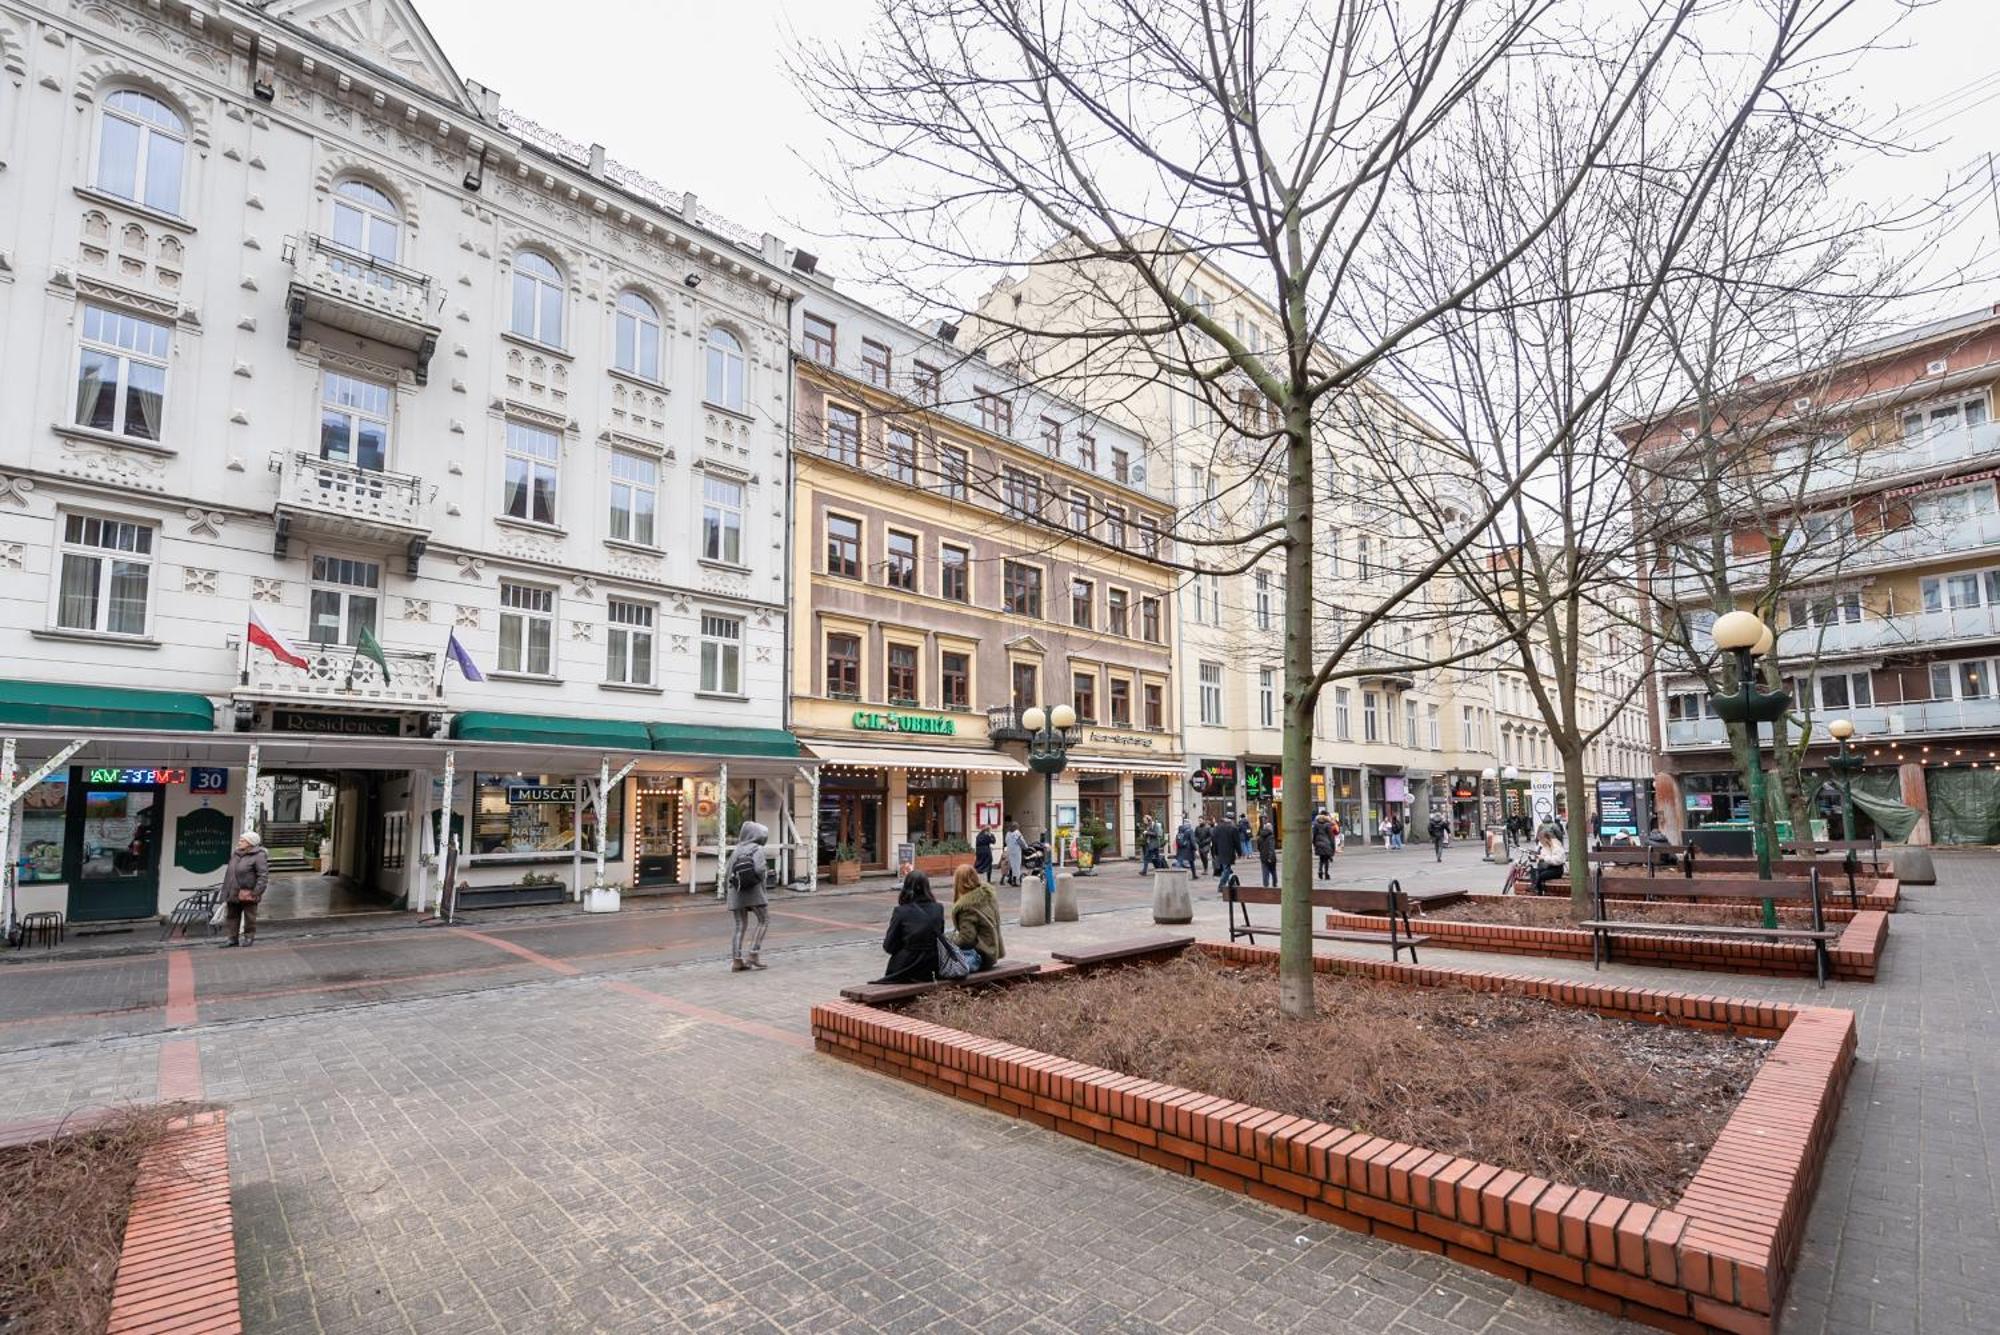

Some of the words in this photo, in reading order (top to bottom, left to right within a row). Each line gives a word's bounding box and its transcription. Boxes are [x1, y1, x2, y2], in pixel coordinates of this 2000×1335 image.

[287, 714, 389, 733] Residence
[197, 773, 222, 788] 30
[519, 789, 577, 801] MUSCAT
